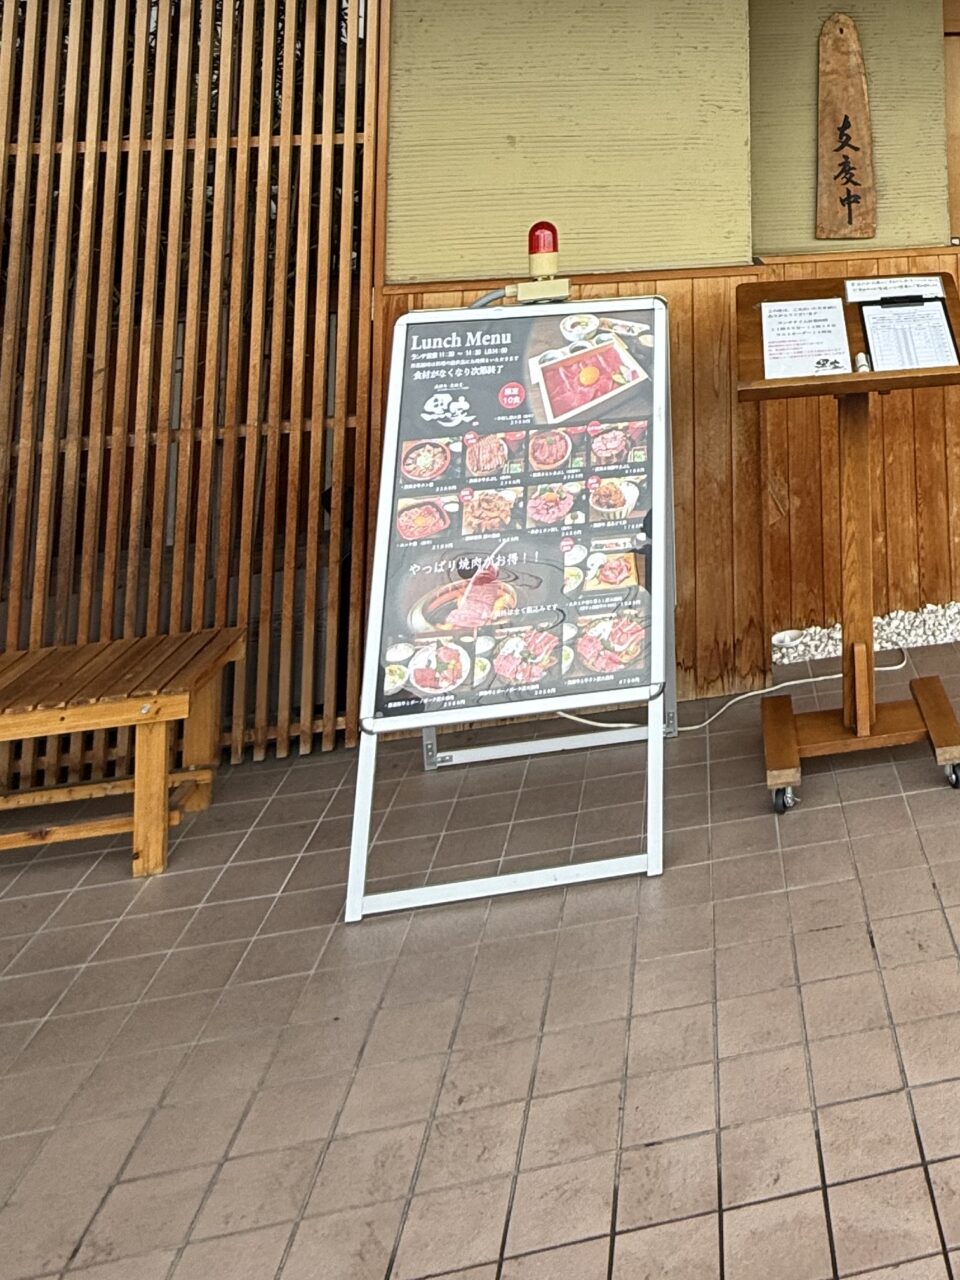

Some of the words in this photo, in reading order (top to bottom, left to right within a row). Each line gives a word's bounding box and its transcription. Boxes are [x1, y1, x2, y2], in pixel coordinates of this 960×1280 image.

[832, 114, 862, 226] 支度中
[410, 331, 462, 351] Lunch
[464, 330, 512, 347] Menu
